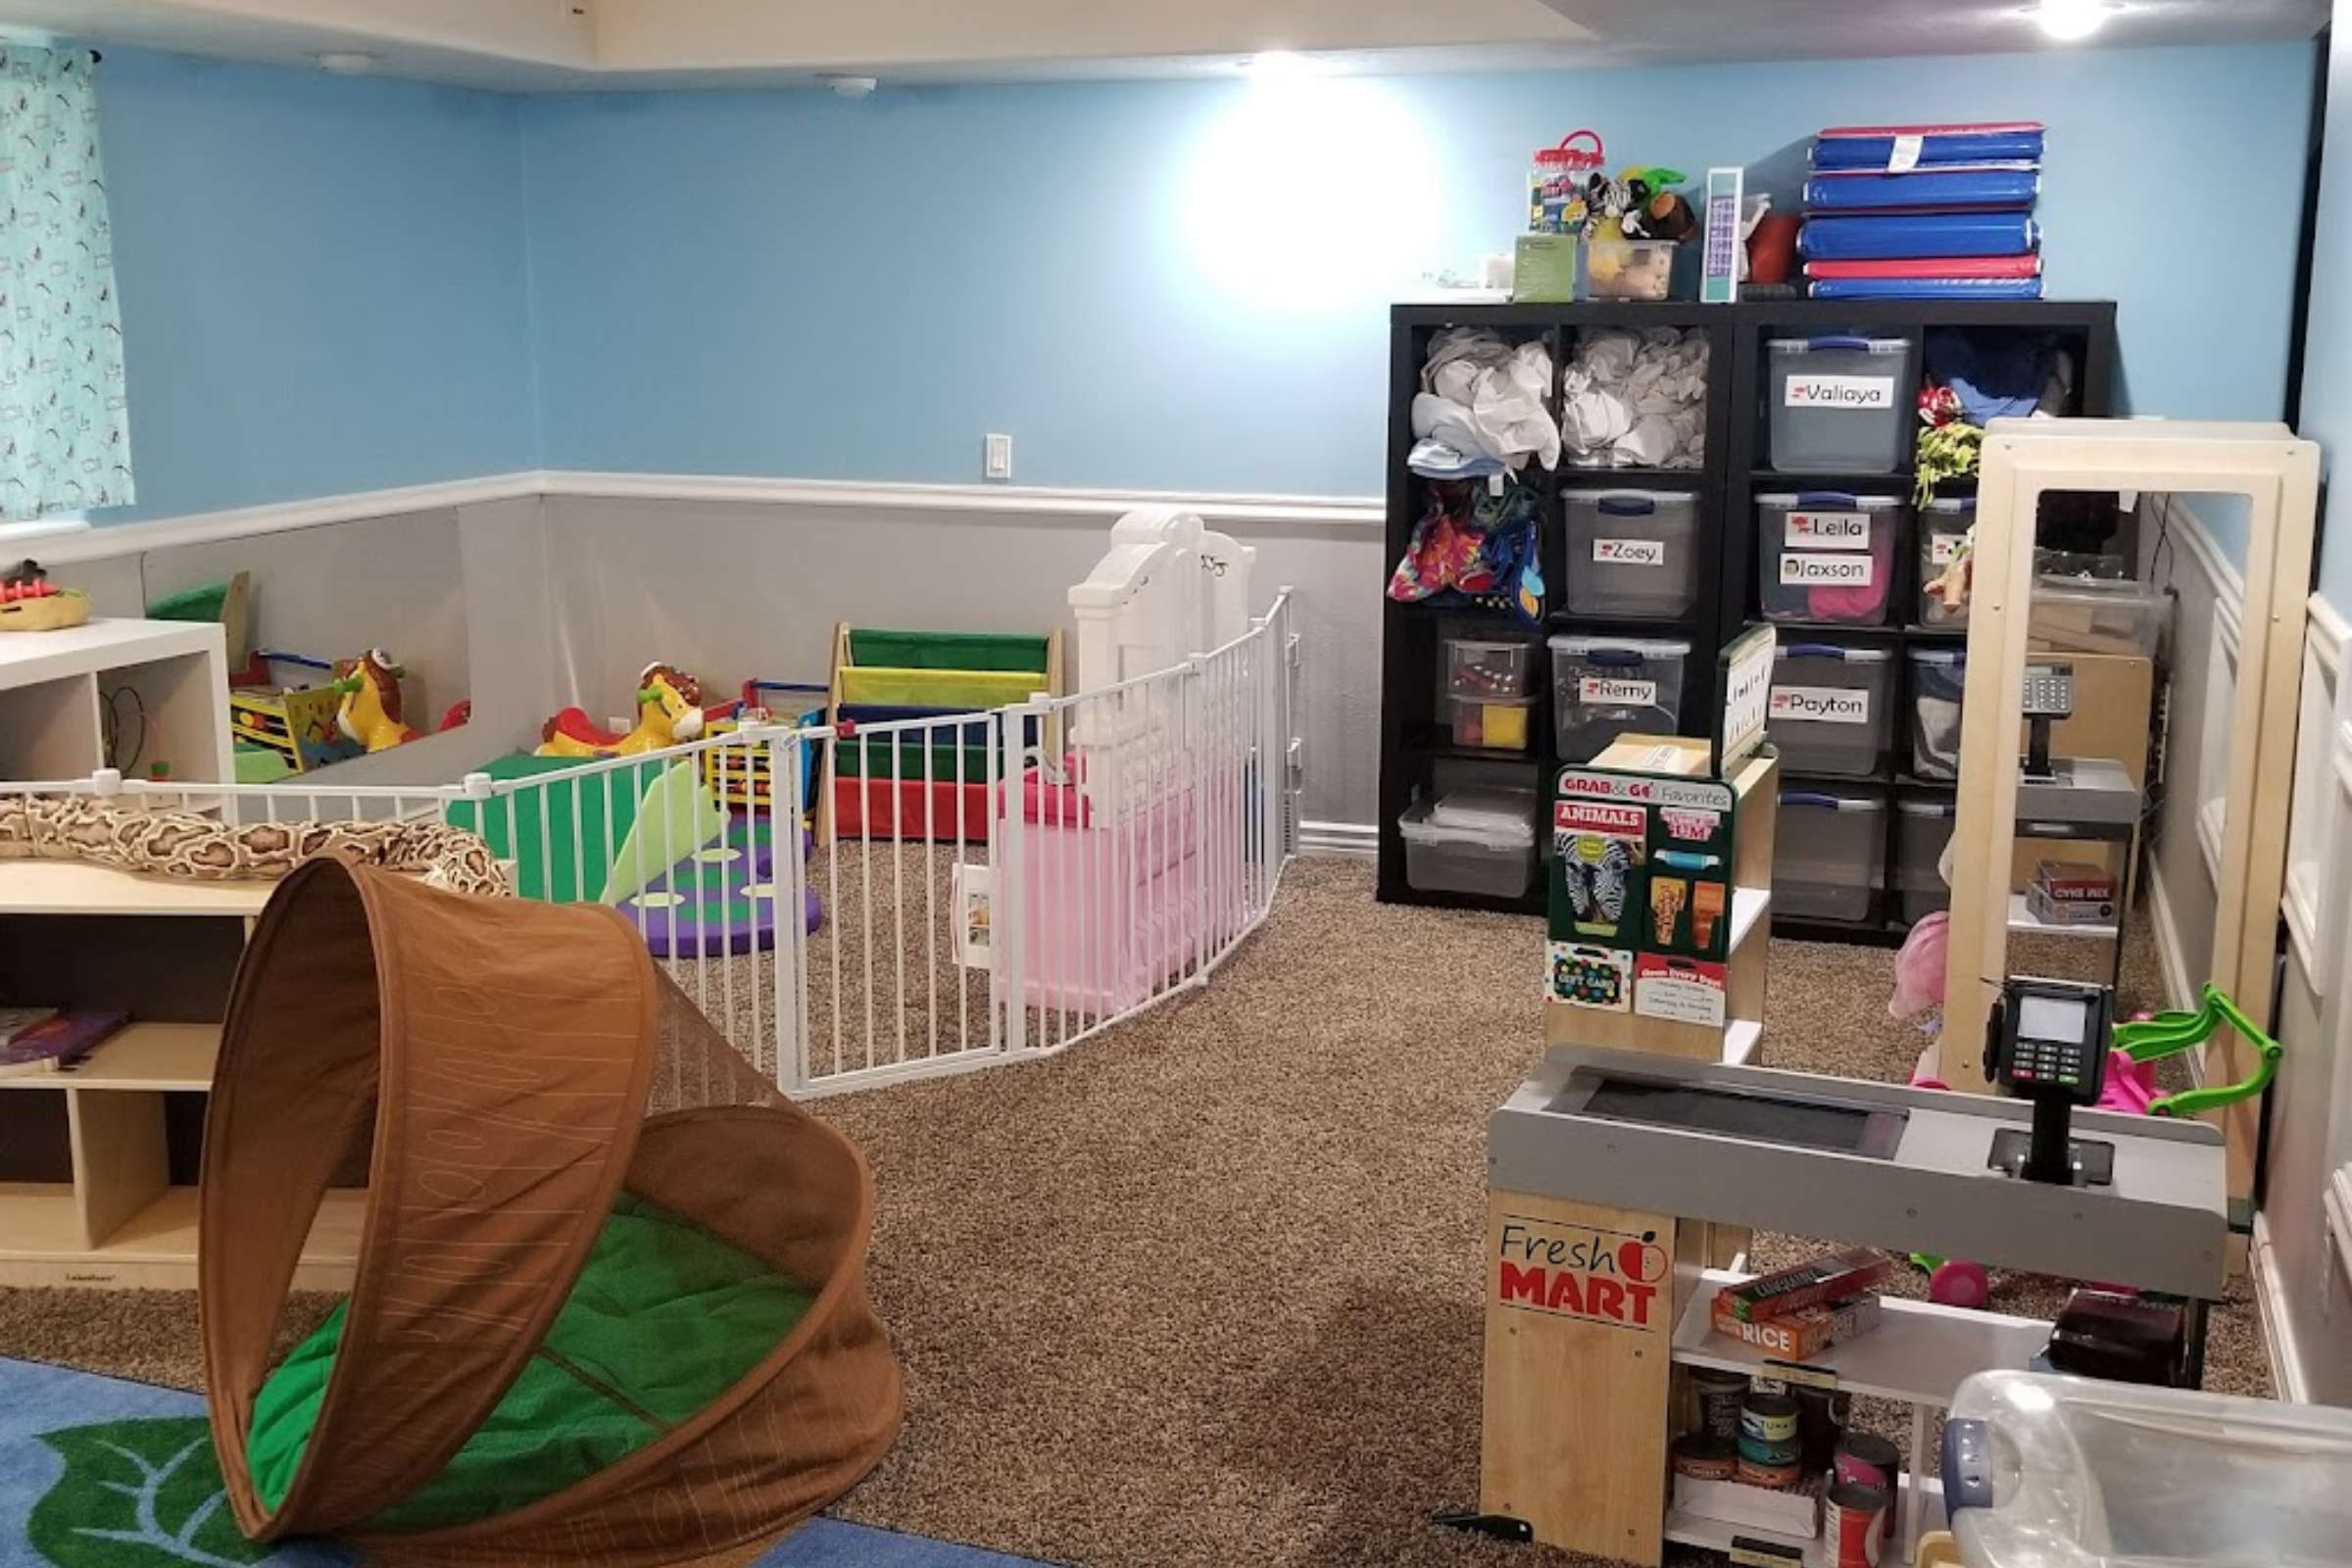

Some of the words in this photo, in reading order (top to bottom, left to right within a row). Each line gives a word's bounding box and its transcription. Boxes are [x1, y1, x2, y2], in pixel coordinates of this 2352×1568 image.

[1806, 383, 1881, 405] Valiaya
[1814, 517, 1862, 536] Leila
[1613, 541, 1656, 564] Zoey
[1799, 559, 1864, 578] Jaxson
[1599, 680, 1652, 701] Remy
[1790, 693, 1862, 715] Payton
[1564, 777, 1611, 795] GRAB
[1661, 786, 1729, 806] Favorites
[1560, 806, 1640, 826] ANIMALS
[1500, 1224, 1615, 1274] Fresh
[1500, 1260, 1656, 1325] MART
[1741, 1323, 1790, 1352] RICE
